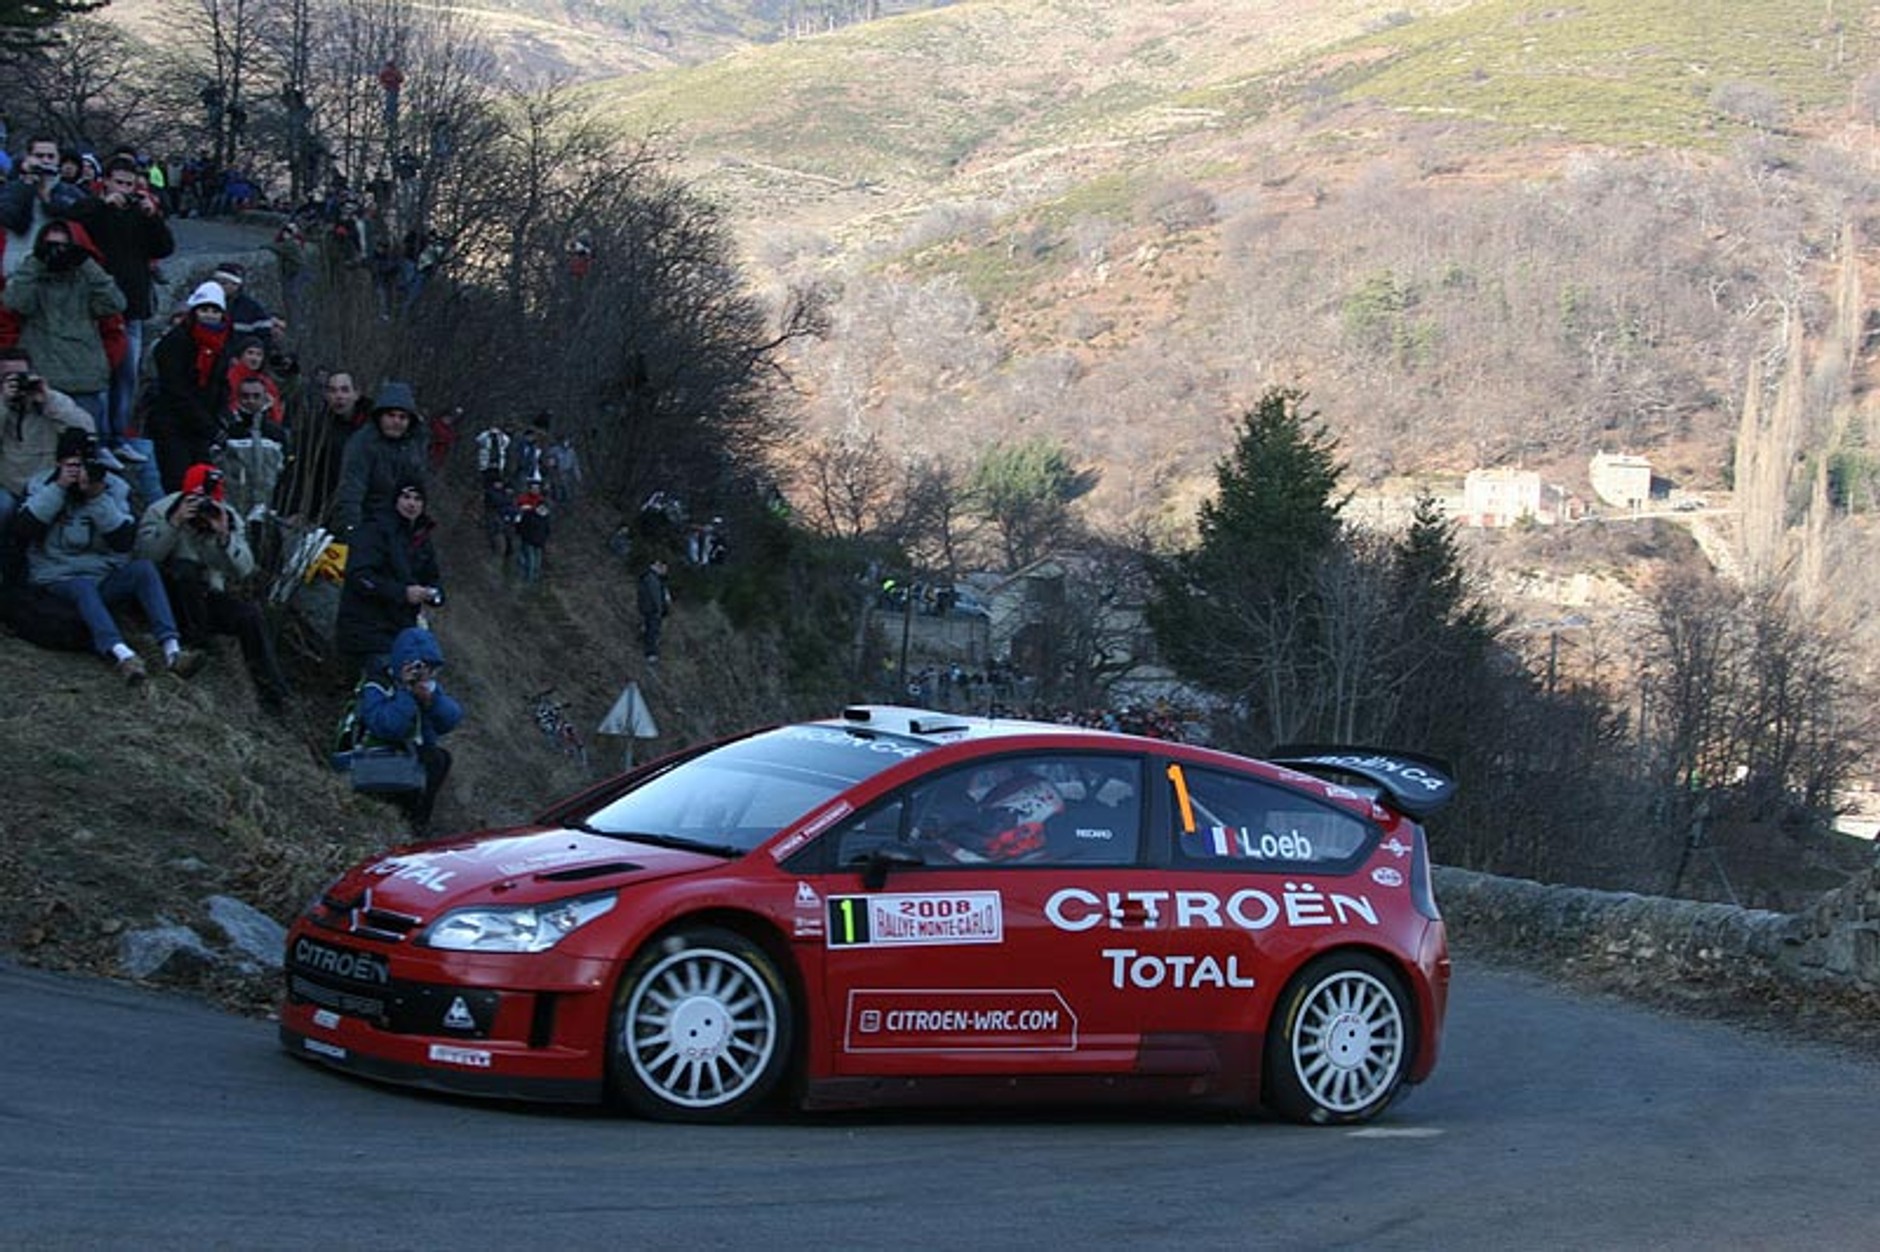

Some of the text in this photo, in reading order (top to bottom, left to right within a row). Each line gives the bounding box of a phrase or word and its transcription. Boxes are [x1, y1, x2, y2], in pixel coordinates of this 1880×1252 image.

[1166, 764, 1196, 833] 1
[1241, 826, 1312, 860] Loeb
[840, 899, 854, 943] 1
[876, 905, 916, 938] RALLYE
[899, 899, 972, 918] 2008
[1044, 882, 1379, 931] CITROËN
[295, 938, 389, 984] CITROËN
[1102, 948, 1255, 988] TOTAL
[886, 1009, 1059, 1031] CITROEN-WRC.COM
